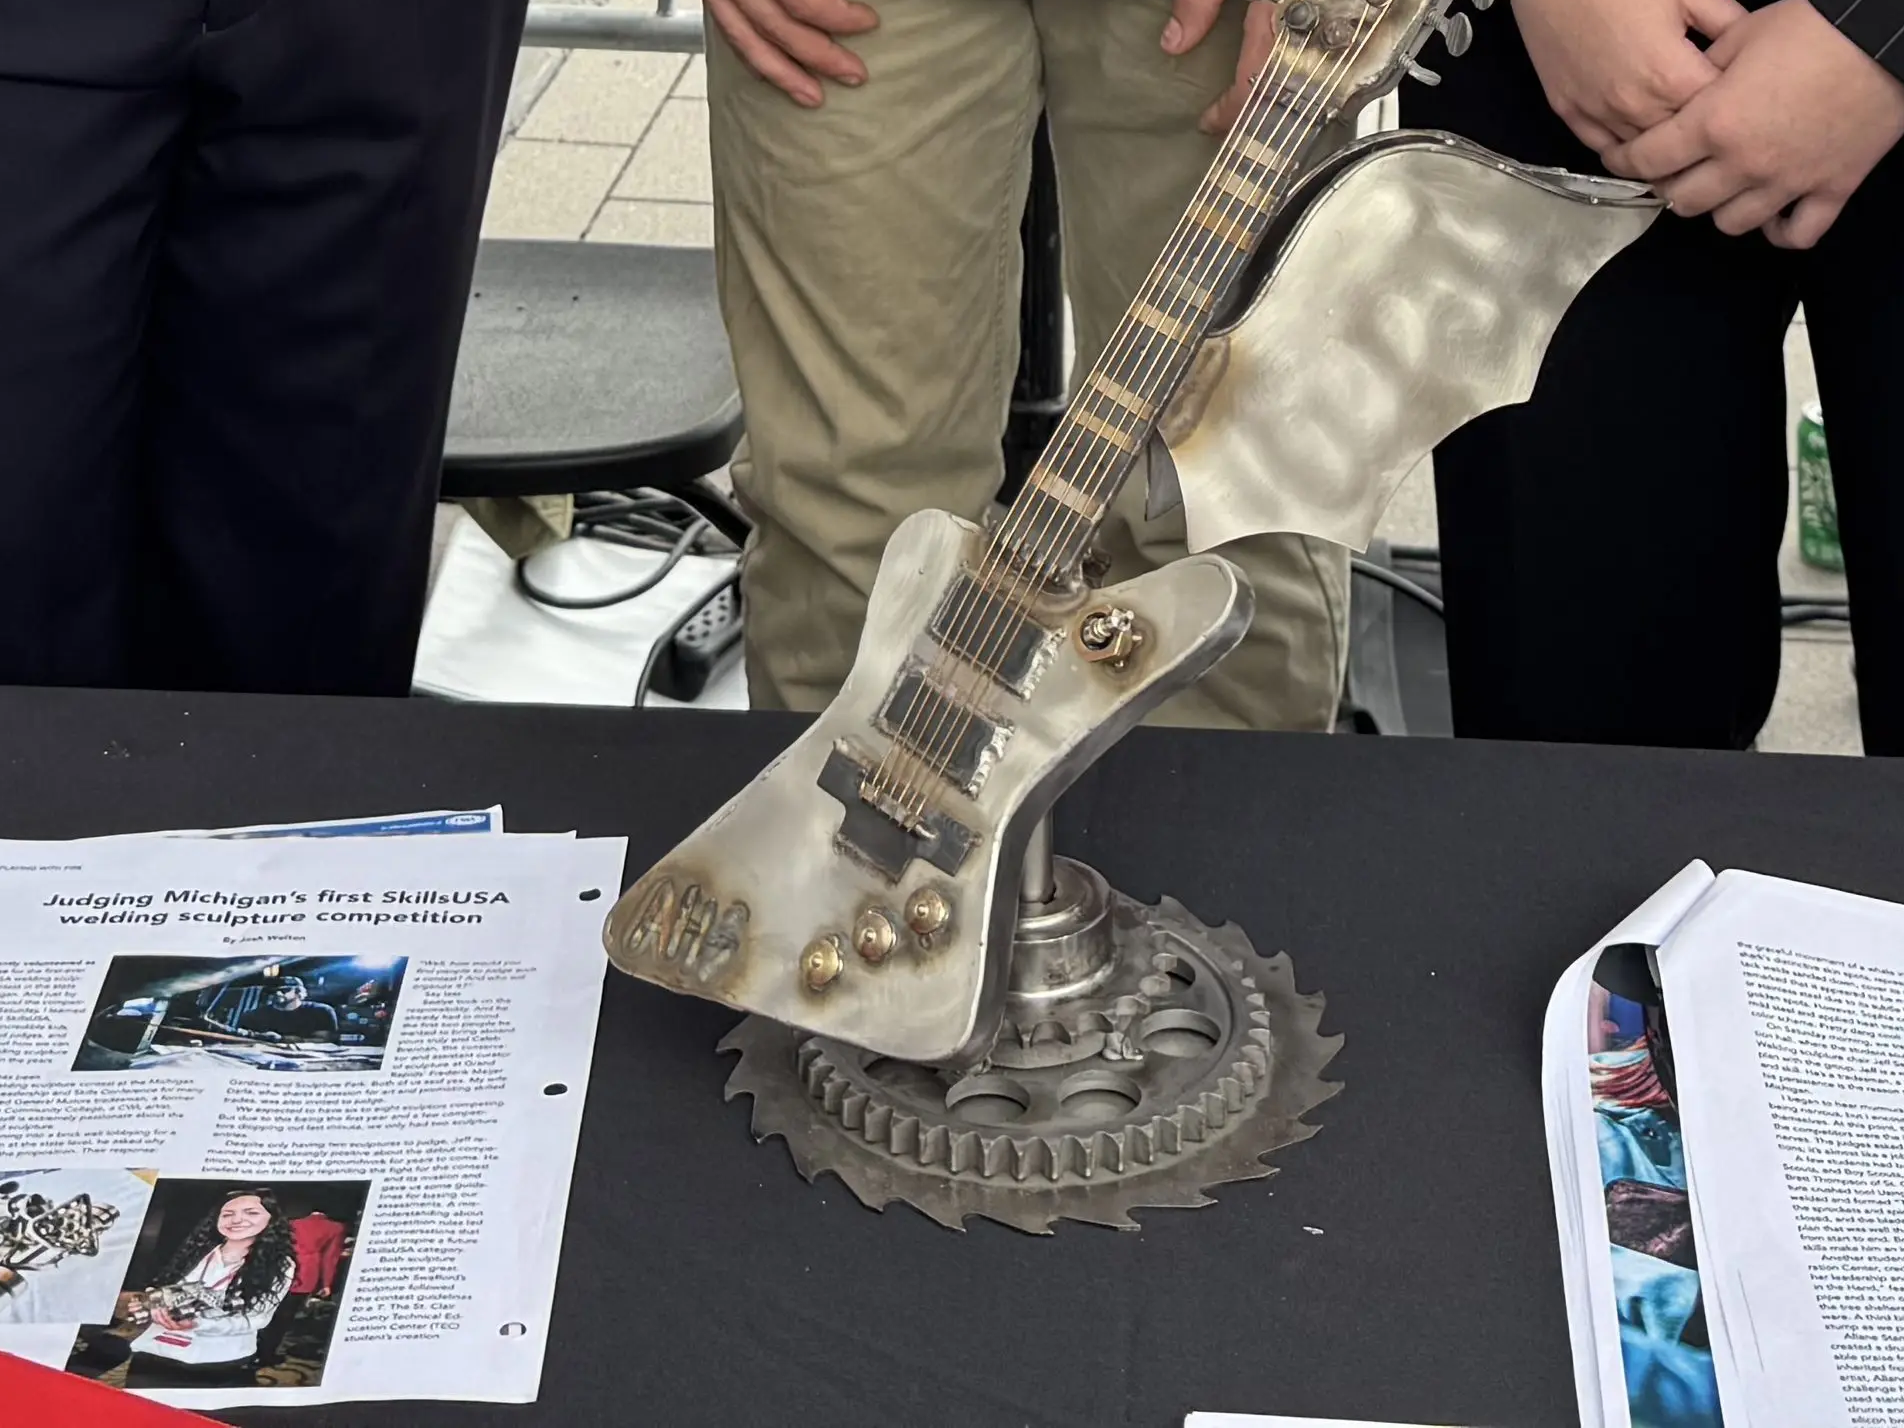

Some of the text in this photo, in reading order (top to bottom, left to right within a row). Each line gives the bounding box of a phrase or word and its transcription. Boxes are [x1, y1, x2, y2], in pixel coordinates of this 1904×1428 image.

[44, 889, 510, 910] Judging Michigan's first SkillsUSA
[60, 909, 483, 927] welding sculpture competition
